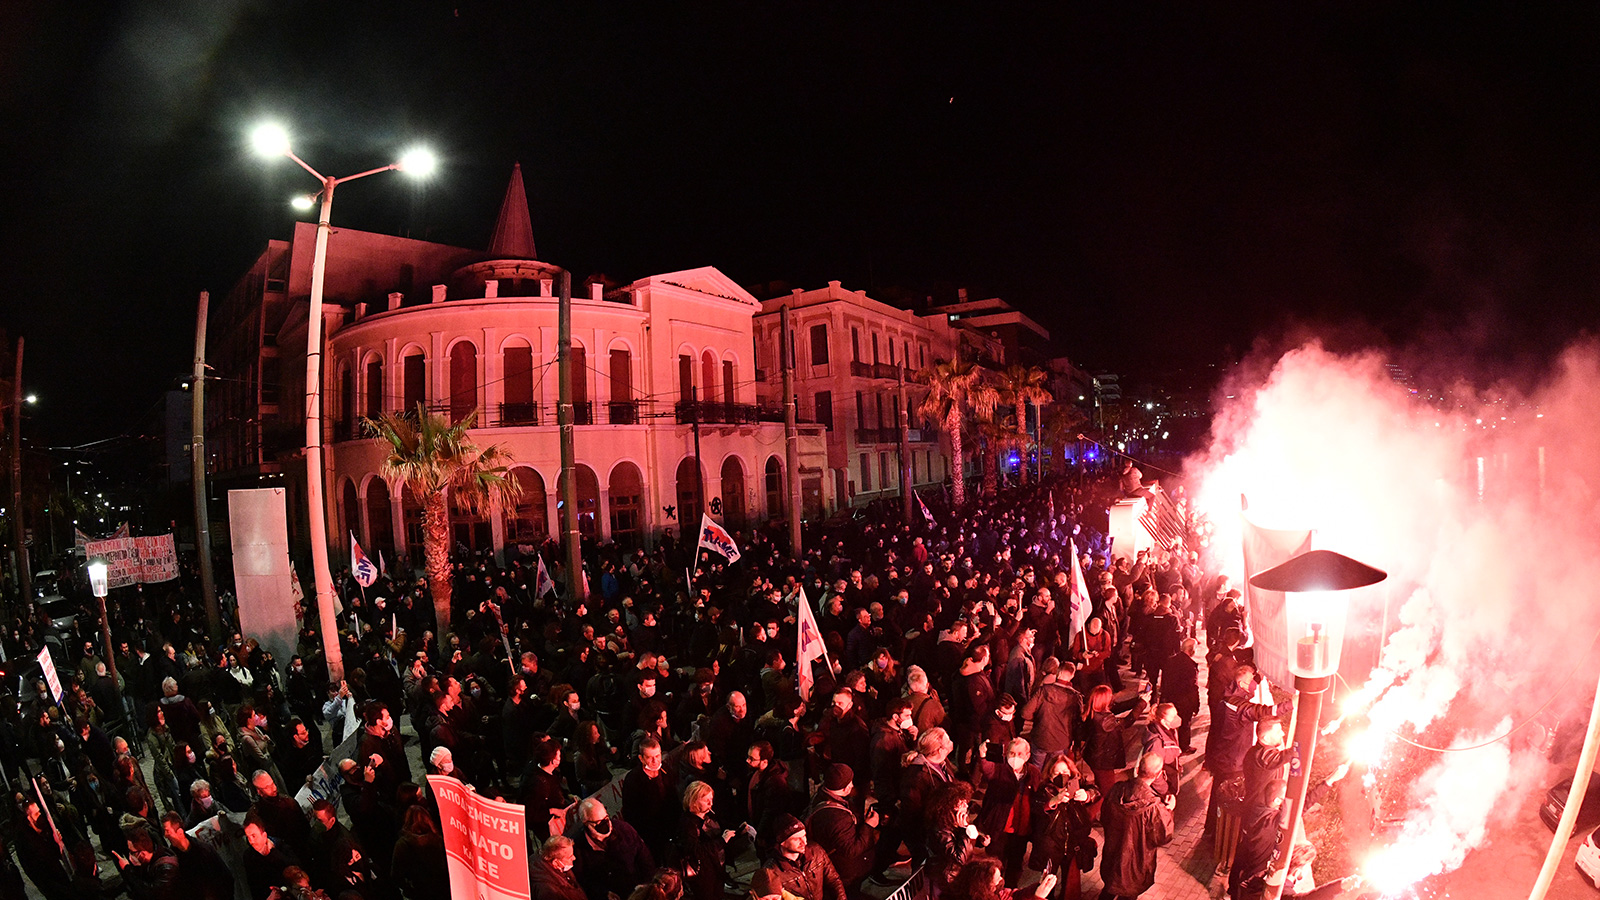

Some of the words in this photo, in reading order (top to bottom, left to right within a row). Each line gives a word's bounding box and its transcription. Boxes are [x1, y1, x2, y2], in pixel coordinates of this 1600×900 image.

[440, 787, 520, 834] ΑΠΟΔΣΜΕΥΣΗ
[468, 828, 514, 860] ΝΑΤΟ
[478, 856, 500, 880] ΕΕ
